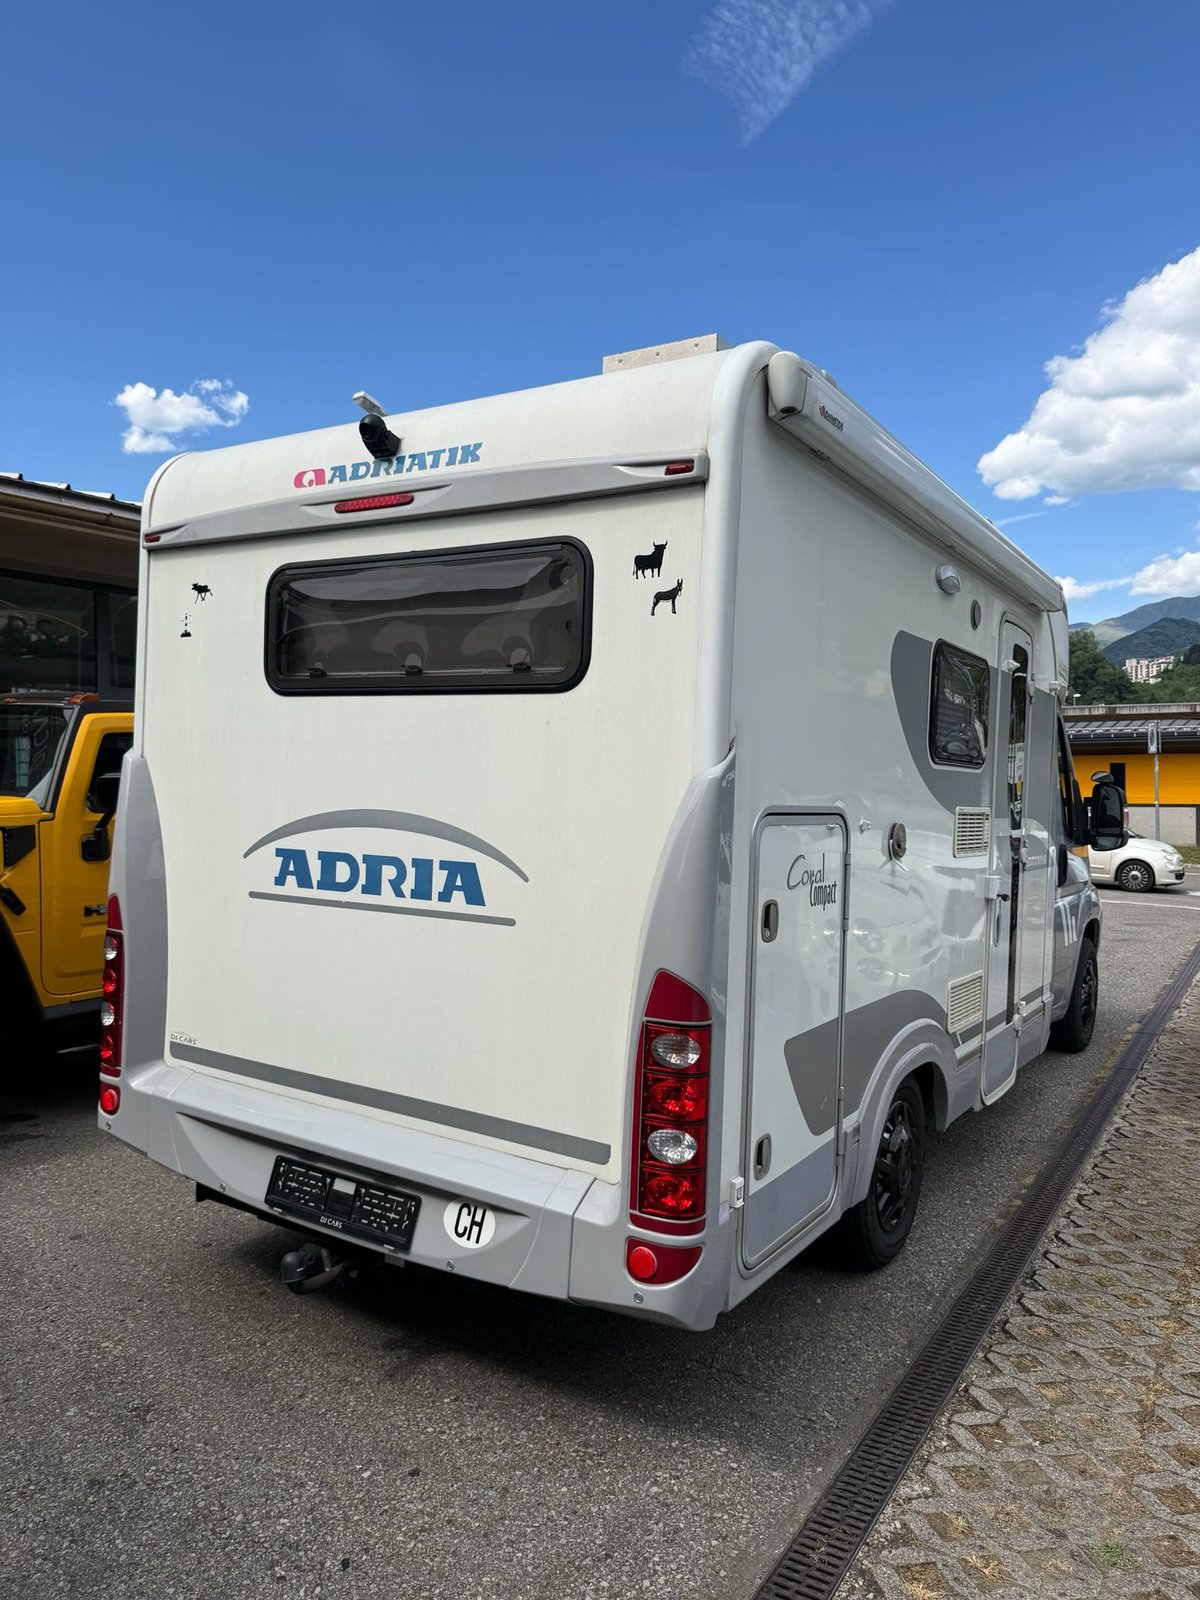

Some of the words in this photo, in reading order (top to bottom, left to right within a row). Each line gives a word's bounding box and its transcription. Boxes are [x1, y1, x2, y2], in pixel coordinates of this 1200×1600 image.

[328, 442, 484, 485] ADRIATIK
[274, 847, 487, 908] ADRIA
[786, 852, 826, 891] Coral
[809, 880, 838, 912] Compact
[179, 1035, 197, 1046] CARS
[327, 1217, 343, 1229] CARS
[454, 1202, 487, 1245] CH
